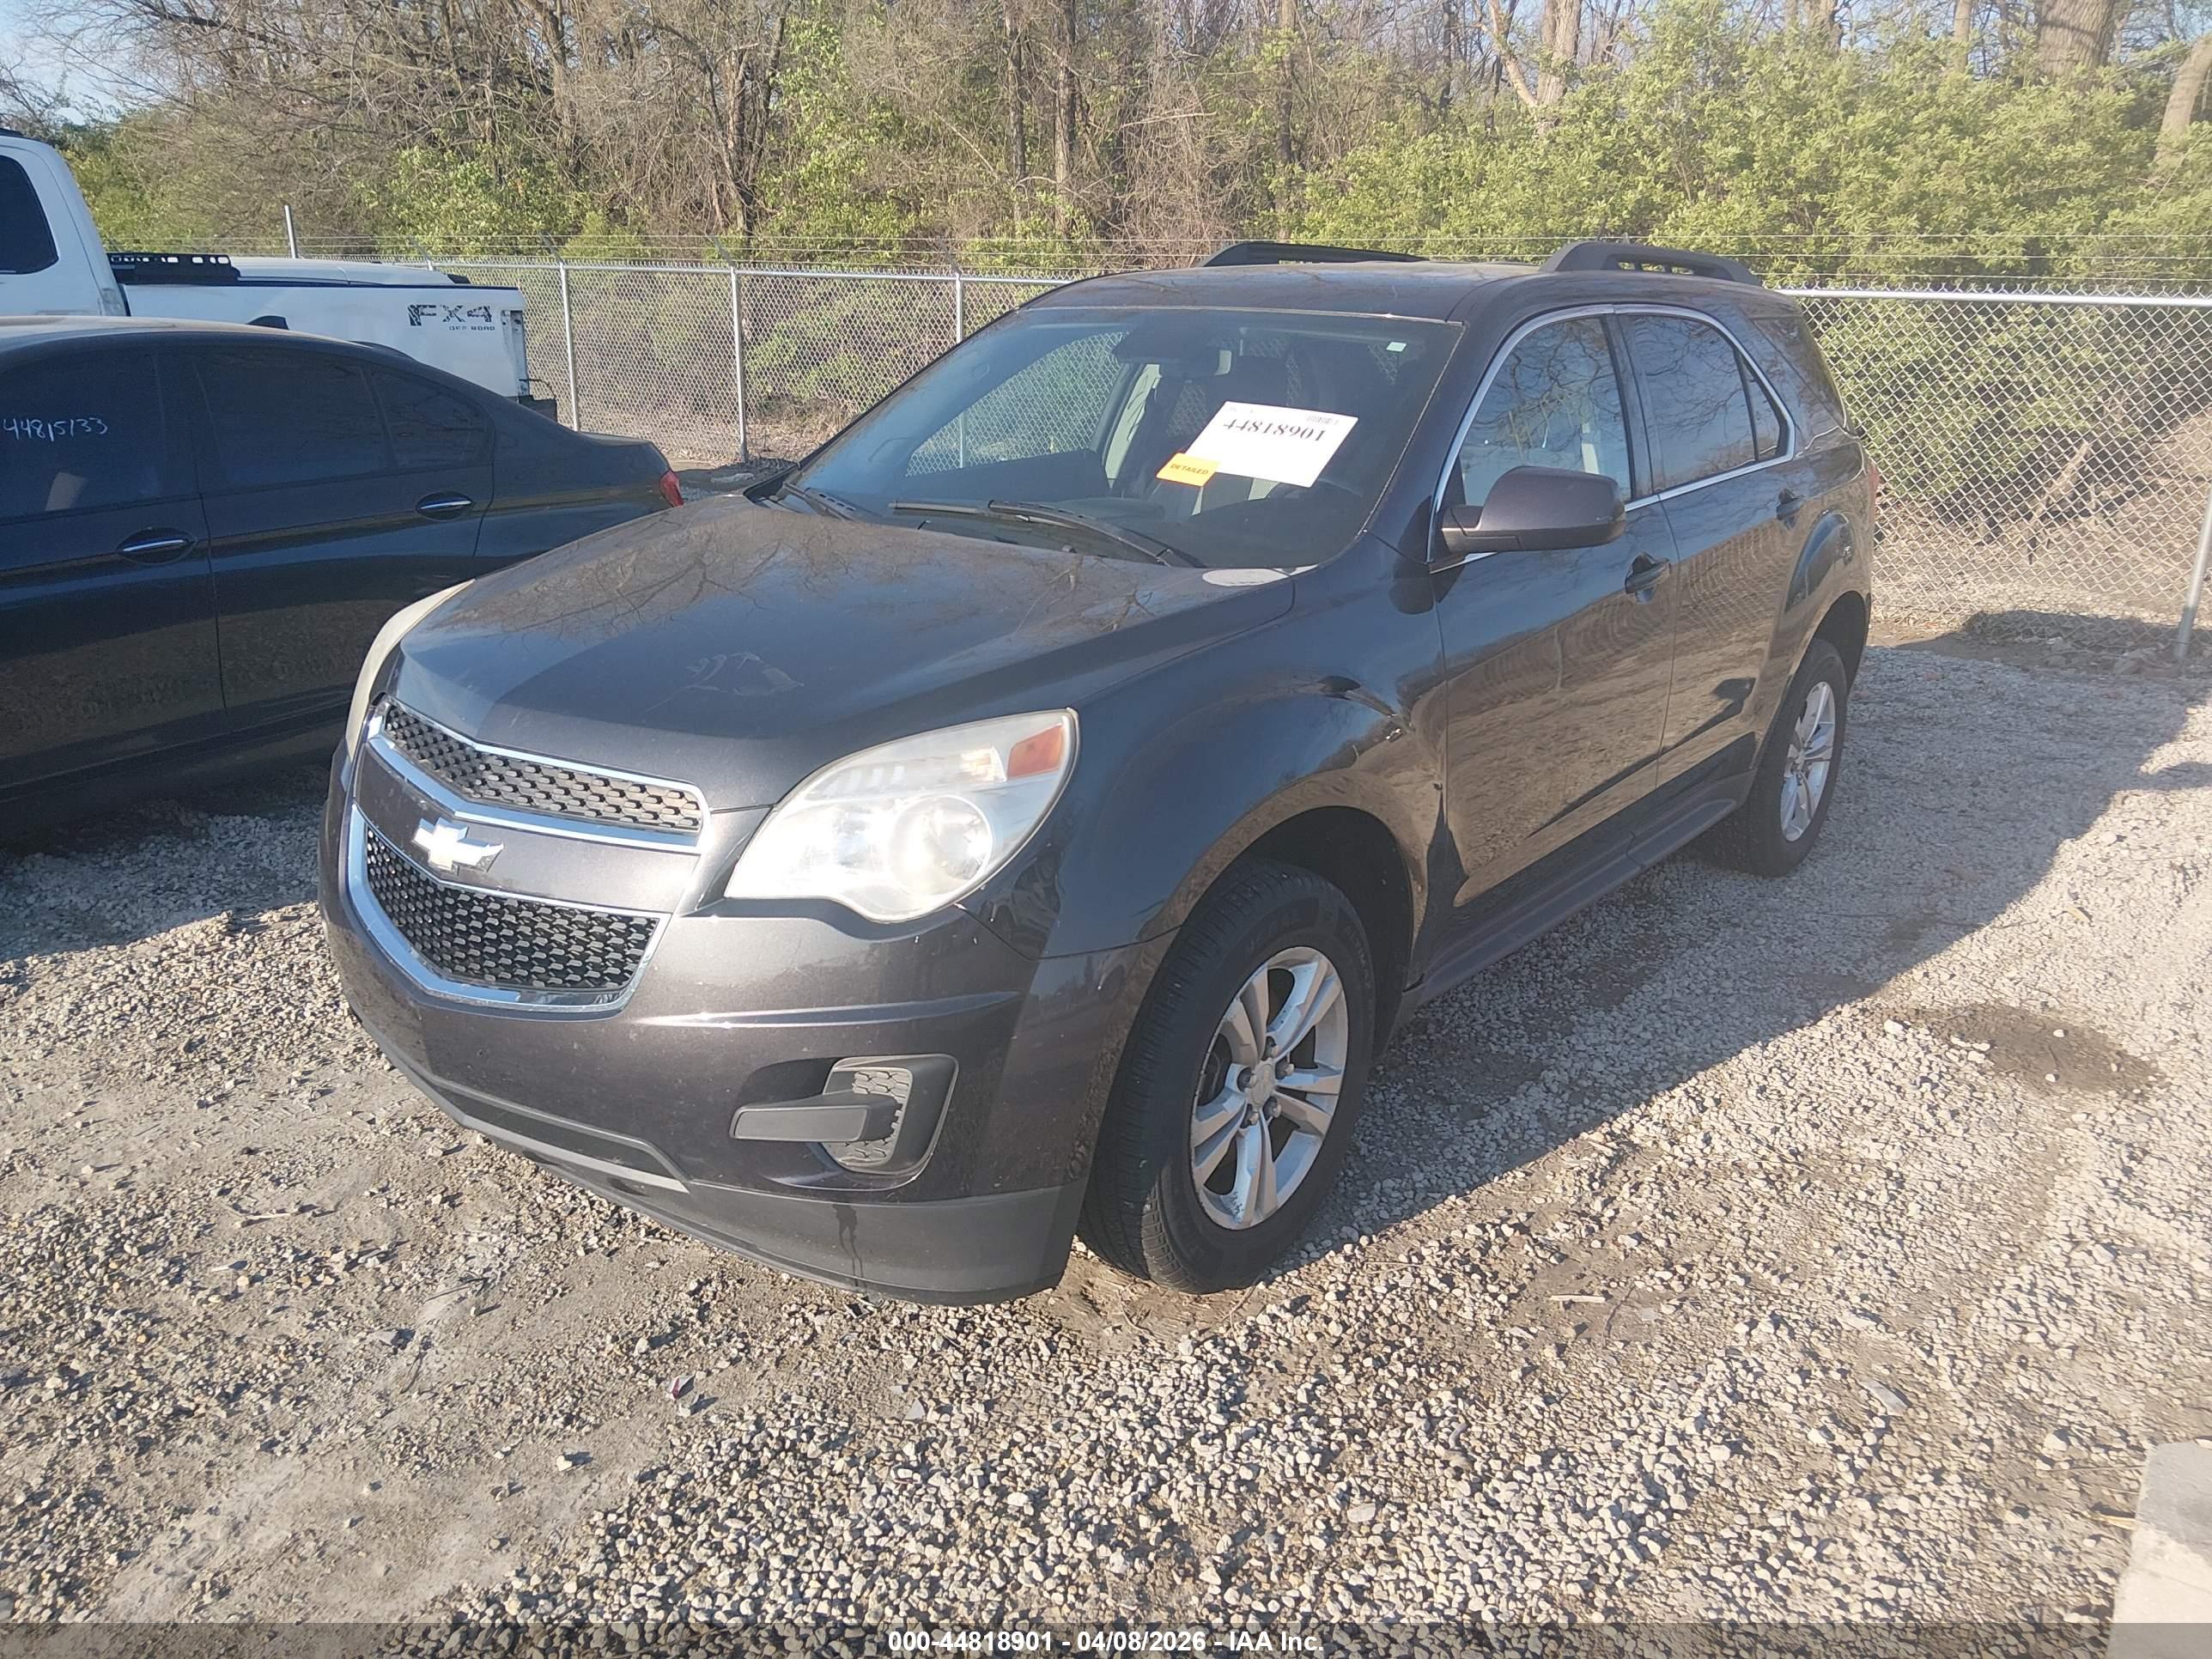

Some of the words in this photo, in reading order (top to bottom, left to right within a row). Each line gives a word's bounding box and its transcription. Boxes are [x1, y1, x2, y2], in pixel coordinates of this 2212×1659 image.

[408, 304, 492, 326] FX4
[3, 417, 108, 441] 44815133
[1223, 417, 1326, 441] 44818901
[1170, 463, 1209, 475] DETAILED
